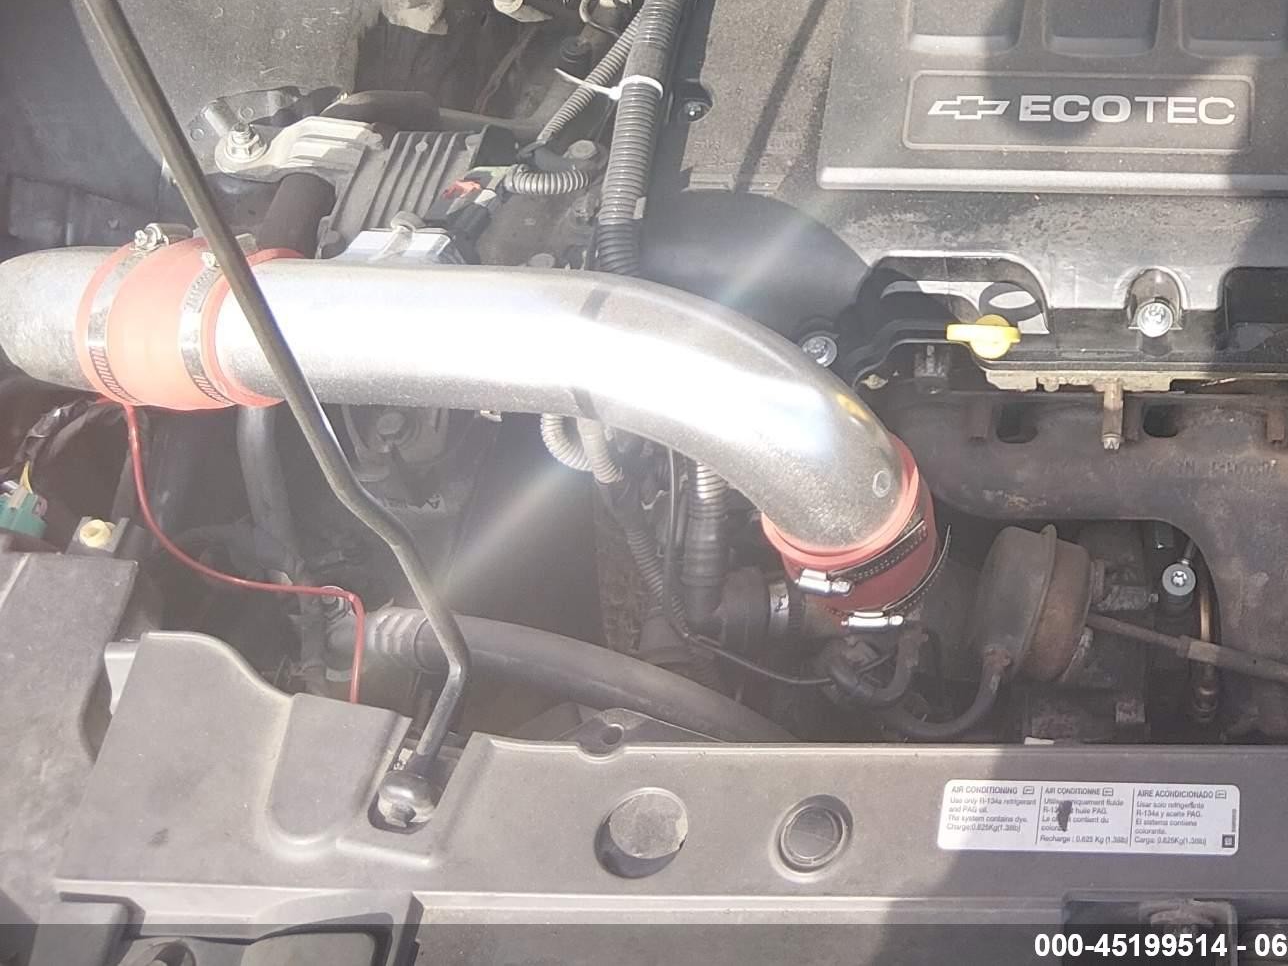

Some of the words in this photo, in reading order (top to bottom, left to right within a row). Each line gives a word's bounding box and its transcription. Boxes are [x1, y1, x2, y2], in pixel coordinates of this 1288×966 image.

[1019, 94, 1236, 125] ECOTEC
[966, 786, 1017, 794] CONDITIONING
[1155, 790, 1213, 798] ACONDICIONADO
